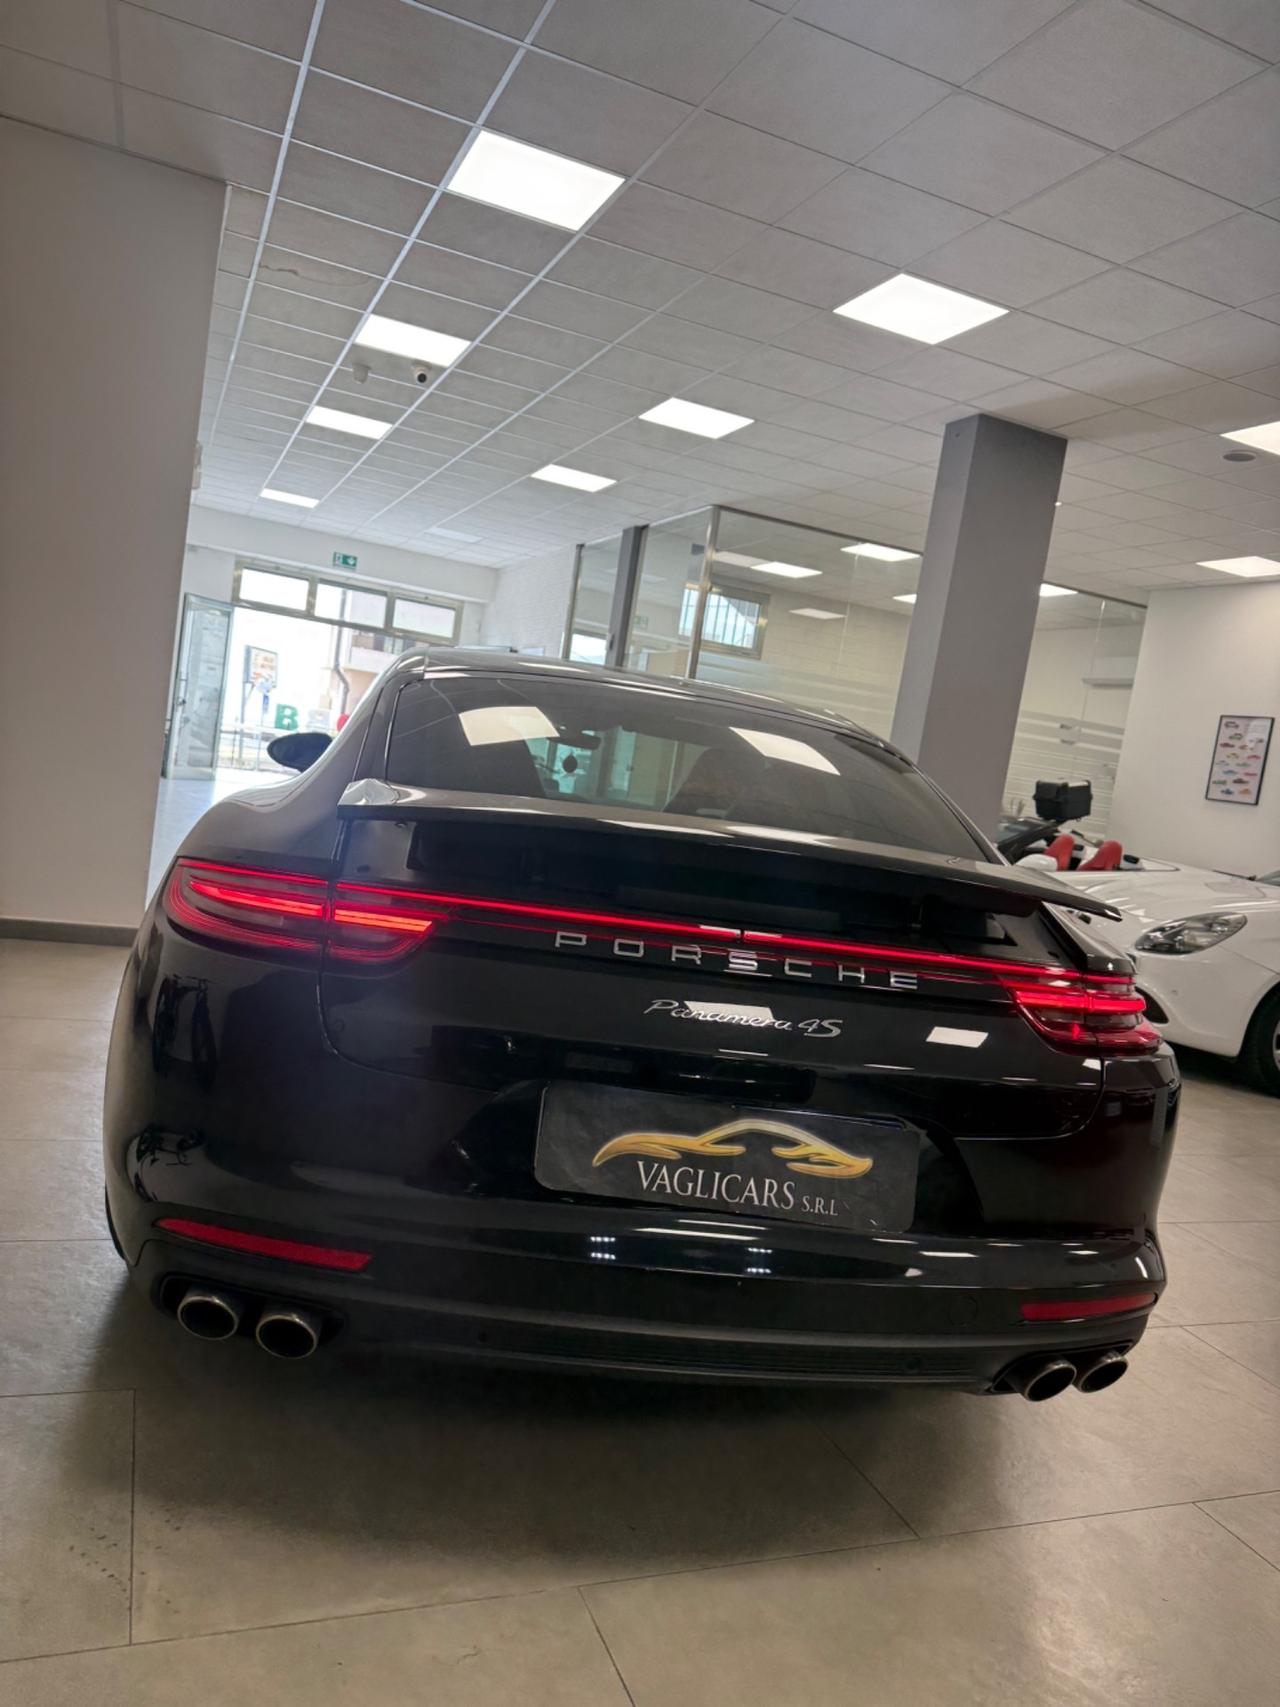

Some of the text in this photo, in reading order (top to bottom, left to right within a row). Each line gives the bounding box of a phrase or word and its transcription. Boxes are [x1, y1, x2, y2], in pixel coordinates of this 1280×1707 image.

[555, 931, 919, 990] PORSCHE
[643, 999, 844, 1038] Panamera 4S
[637, 1160, 796, 1210] VAGLICARS
